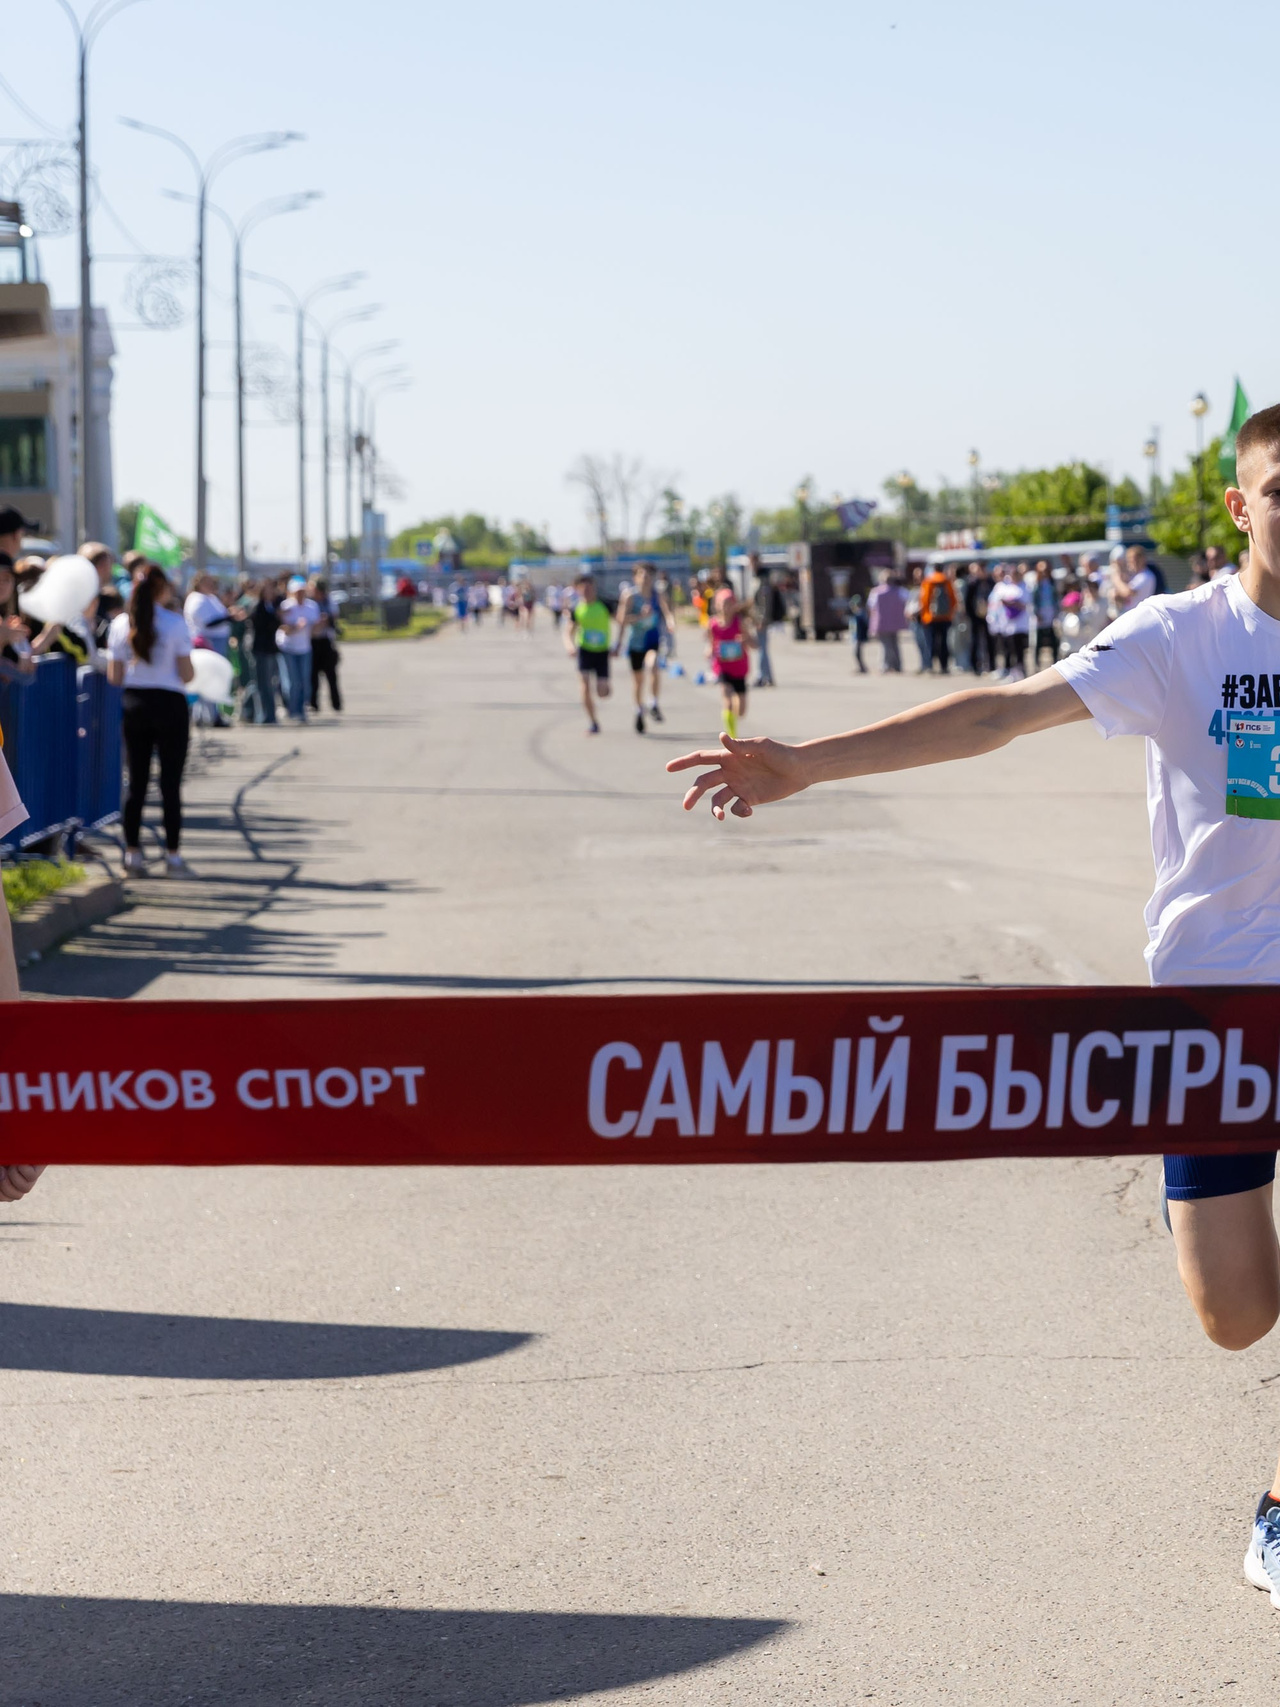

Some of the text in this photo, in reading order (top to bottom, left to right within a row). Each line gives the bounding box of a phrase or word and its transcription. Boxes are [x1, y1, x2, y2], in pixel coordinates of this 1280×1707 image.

[0, 1066, 425, 1111] НИКОВ СПОРТ
[587, 1015, 911, 1138] САМЫЙ
